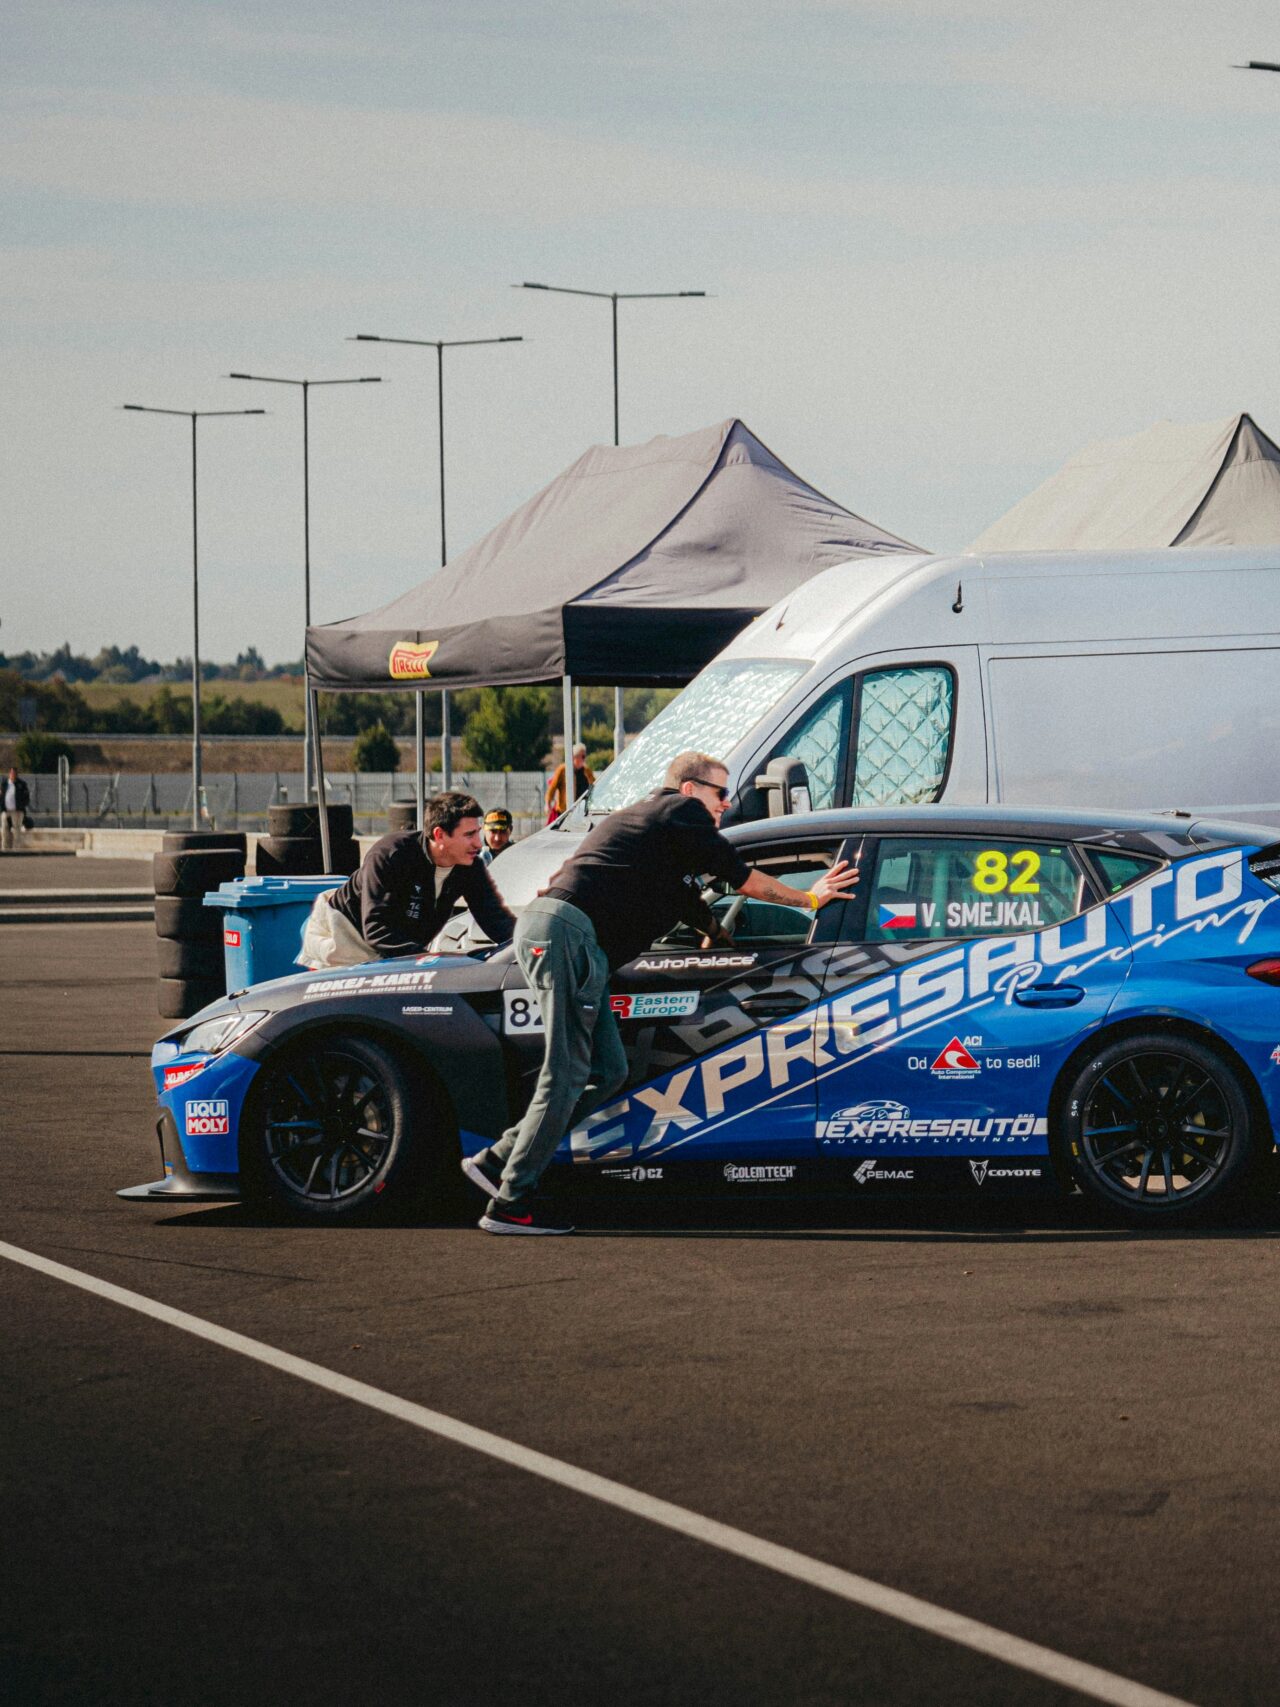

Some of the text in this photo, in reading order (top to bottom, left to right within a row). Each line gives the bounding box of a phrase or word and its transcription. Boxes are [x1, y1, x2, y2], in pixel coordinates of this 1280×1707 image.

[392, 649, 432, 674] PIRELLI
[972, 850, 1041, 895] 82
[920, 901, 1045, 928] V. SMEJKAL
[633, 955, 757, 971] AutoPalace
[305, 971, 438, 994] HOKEJ-KARTY
[569, 850, 1243, 1163] EXPRESAUTO
[634, 994, 696, 1007] Eastern
[632, 1004, 689, 1016] Europe
[963, 1036, 983, 1047] ACI
[907, 1054, 1041, 1070] Od to sedí!
[187, 1103, 226, 1117] LIQUI
[188, 1118, 226, 1133] MOLY
[825, 1118, 1034, 1138] EXPRESAUTO
[731, 1165, 794, 1179] GOLEMTECH
[866, 1170, 914, 1179] PEMAC
[988, 1168, 1042, 1177] COYOTE
